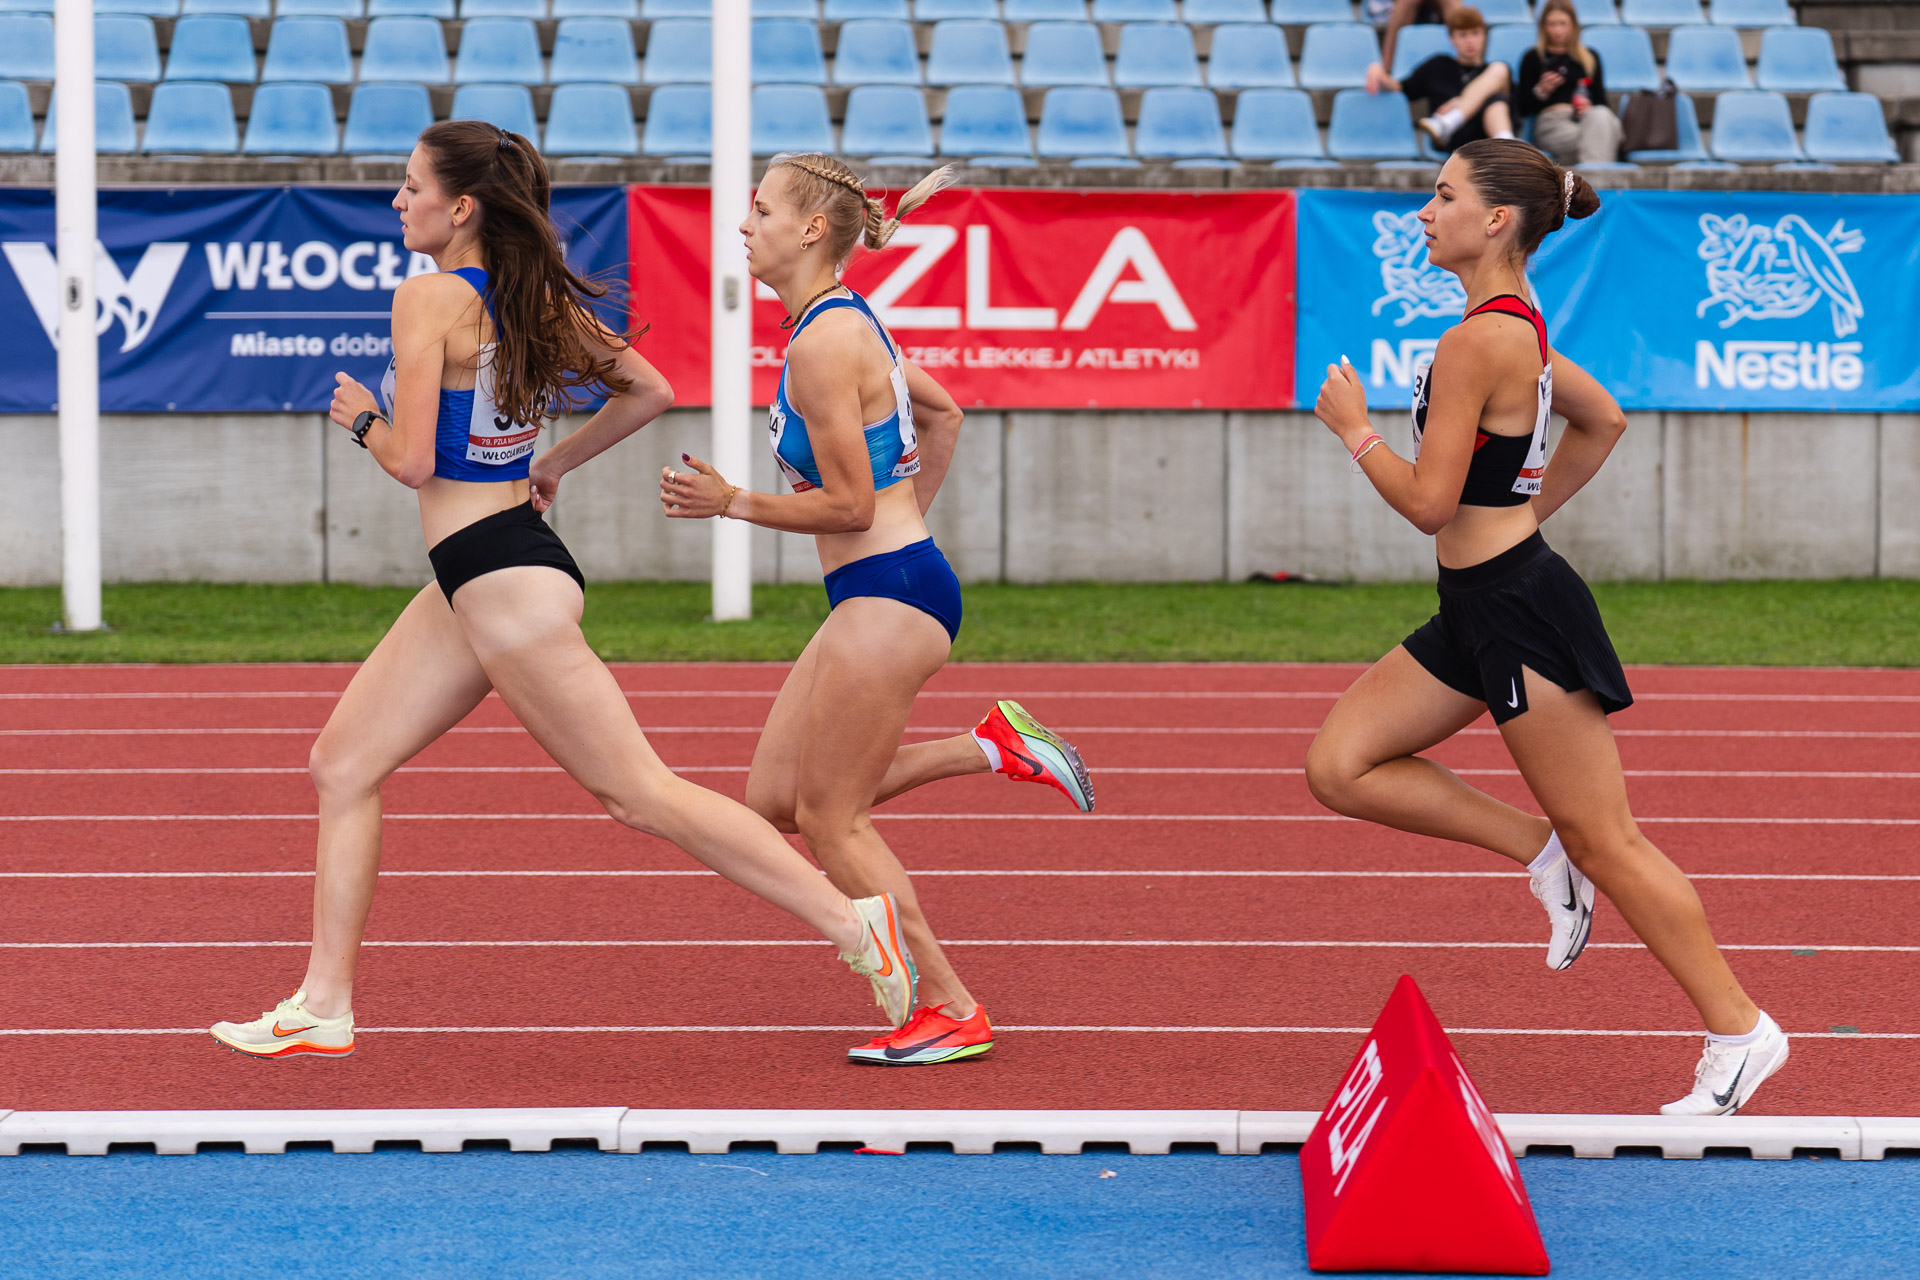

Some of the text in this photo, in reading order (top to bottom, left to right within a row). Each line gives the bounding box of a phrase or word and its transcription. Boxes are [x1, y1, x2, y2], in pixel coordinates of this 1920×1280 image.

[204, 240, 441, 291] WŁOCŁA
[756, 224, 1197, 331] ZLA
[230, 332, 394, 357] Miasto dobr
[963, 347, 1072, 369] LEKKIEJ
[1076, 347, 1199, 369] ATLETYKI
[1695, 339, 1864, 391] Nestlé
